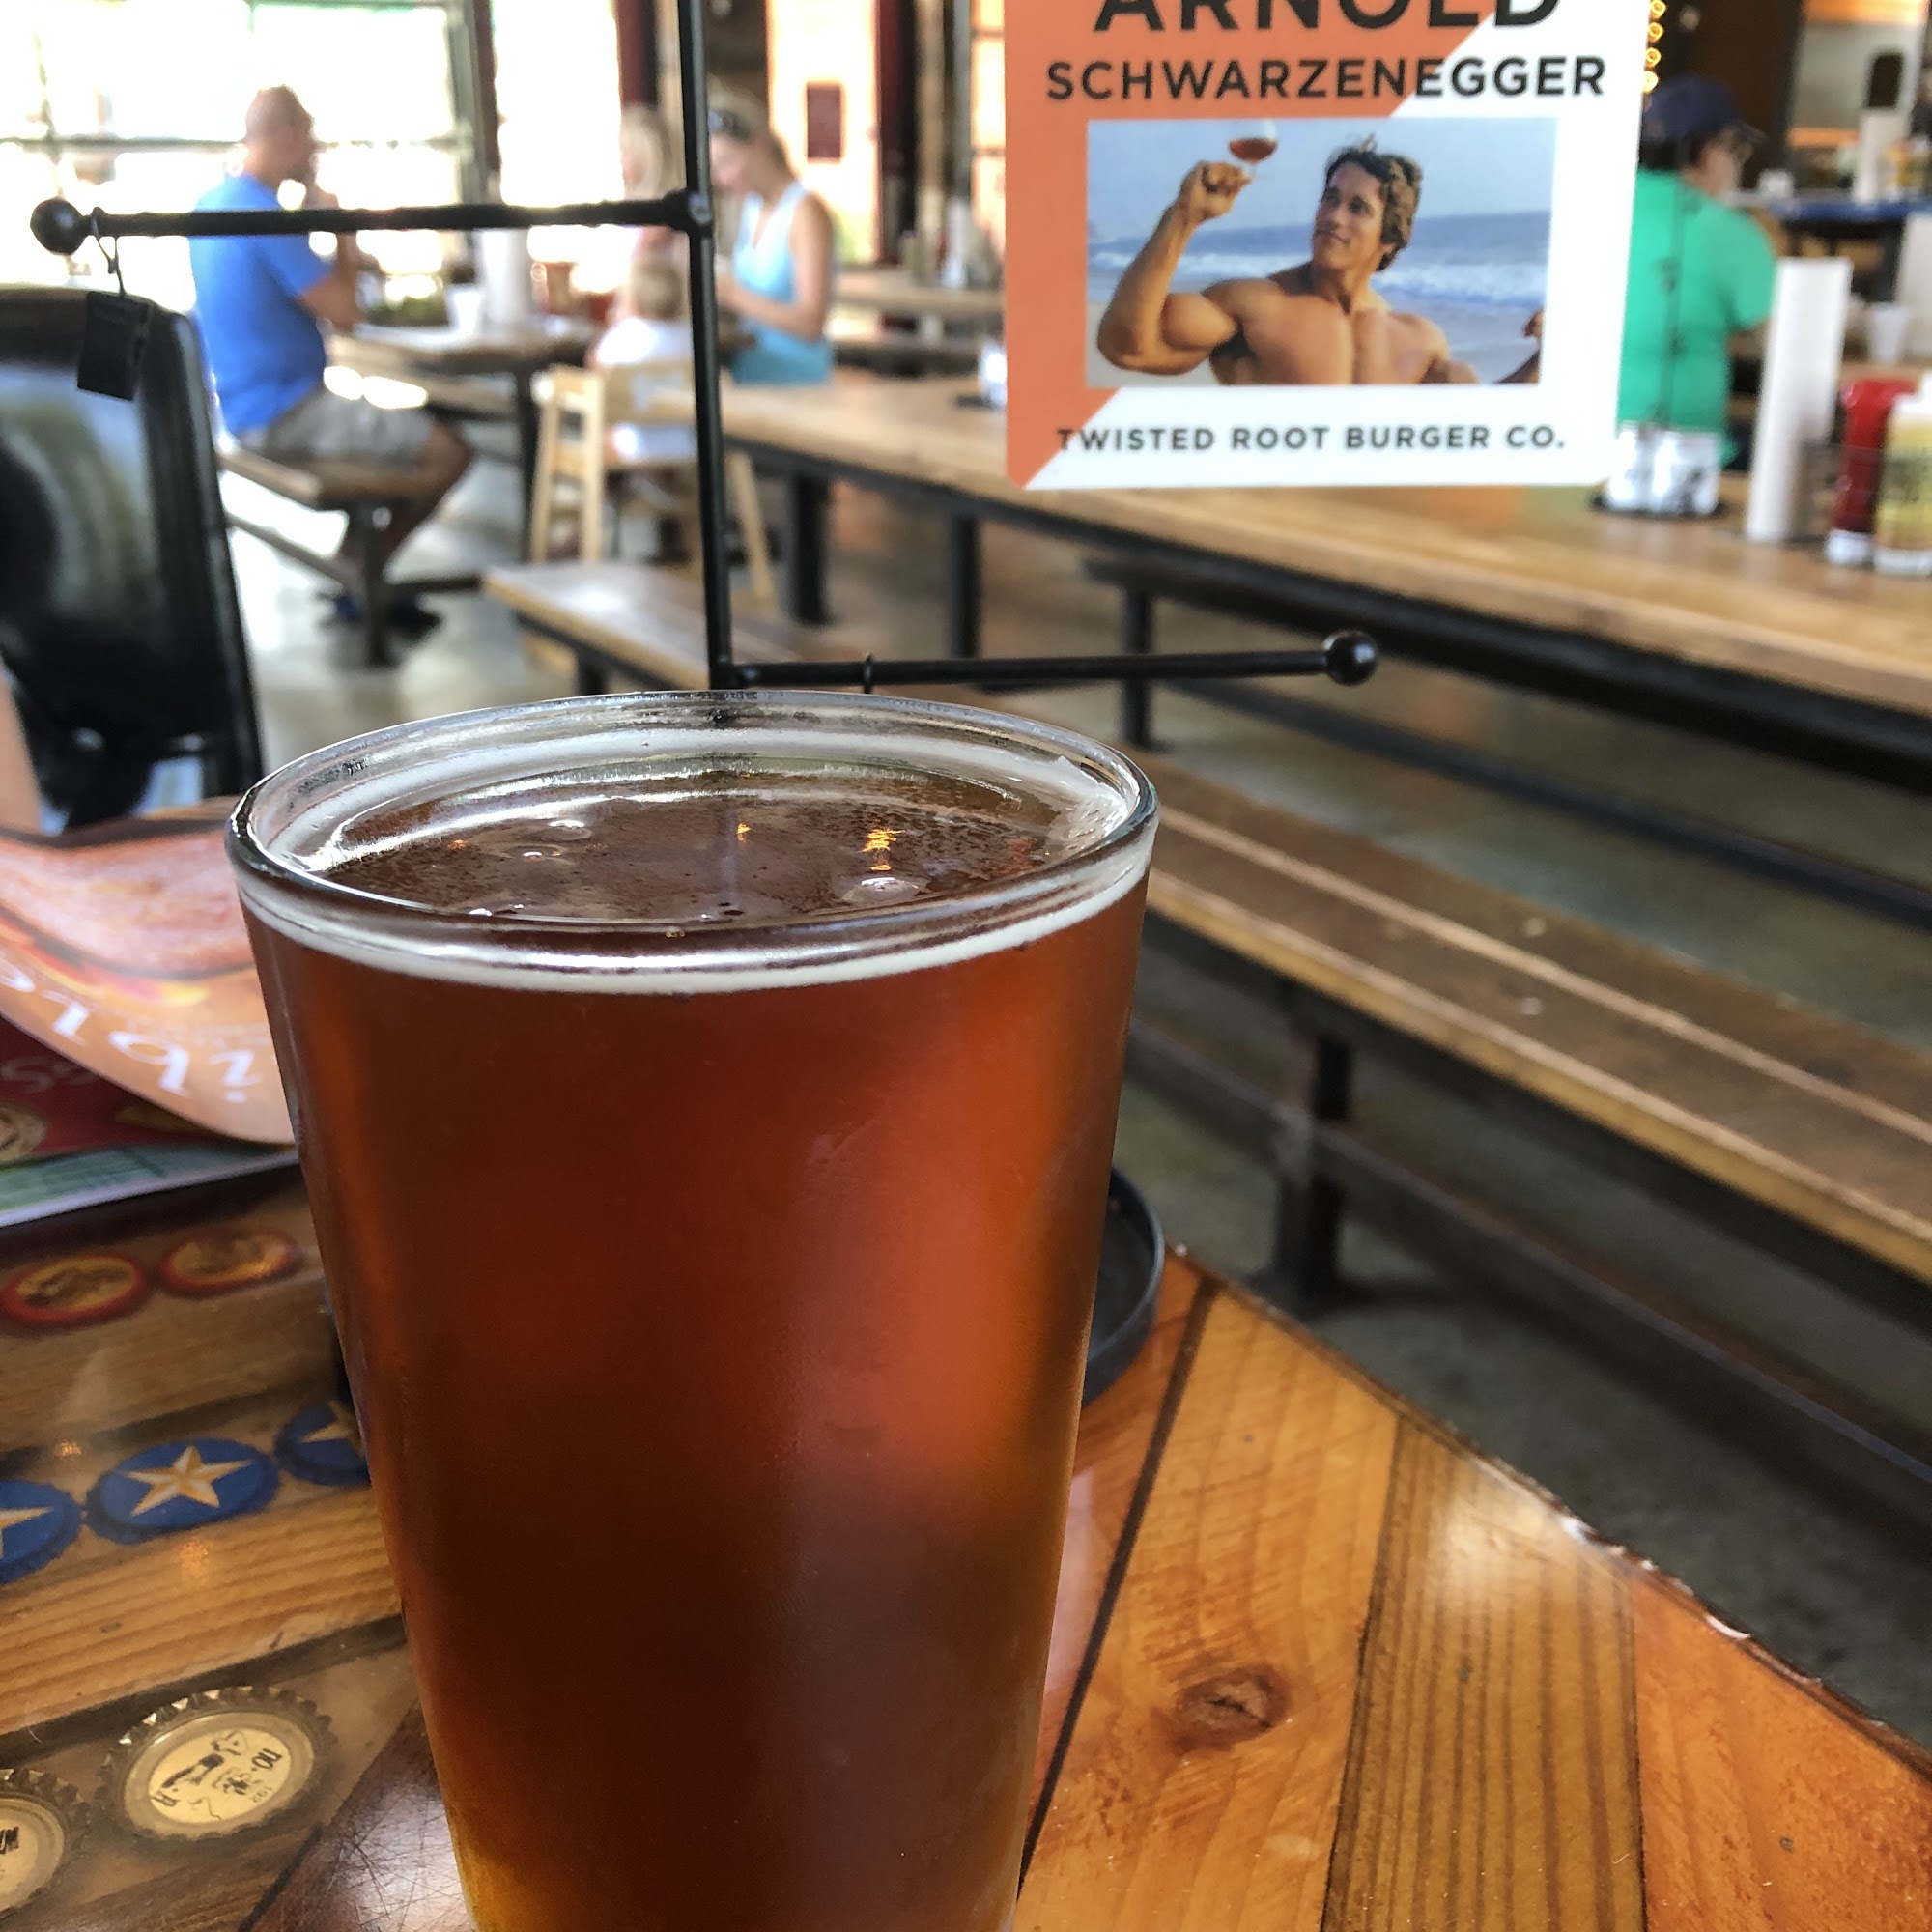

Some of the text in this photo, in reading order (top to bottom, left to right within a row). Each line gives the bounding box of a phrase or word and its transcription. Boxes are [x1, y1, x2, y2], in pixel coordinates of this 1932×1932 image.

[1046, 56, 1605, 101] SCHWARZENEGGER
[1056, 426, 1565, 451] TWISTED ROOT BURGER CO.
